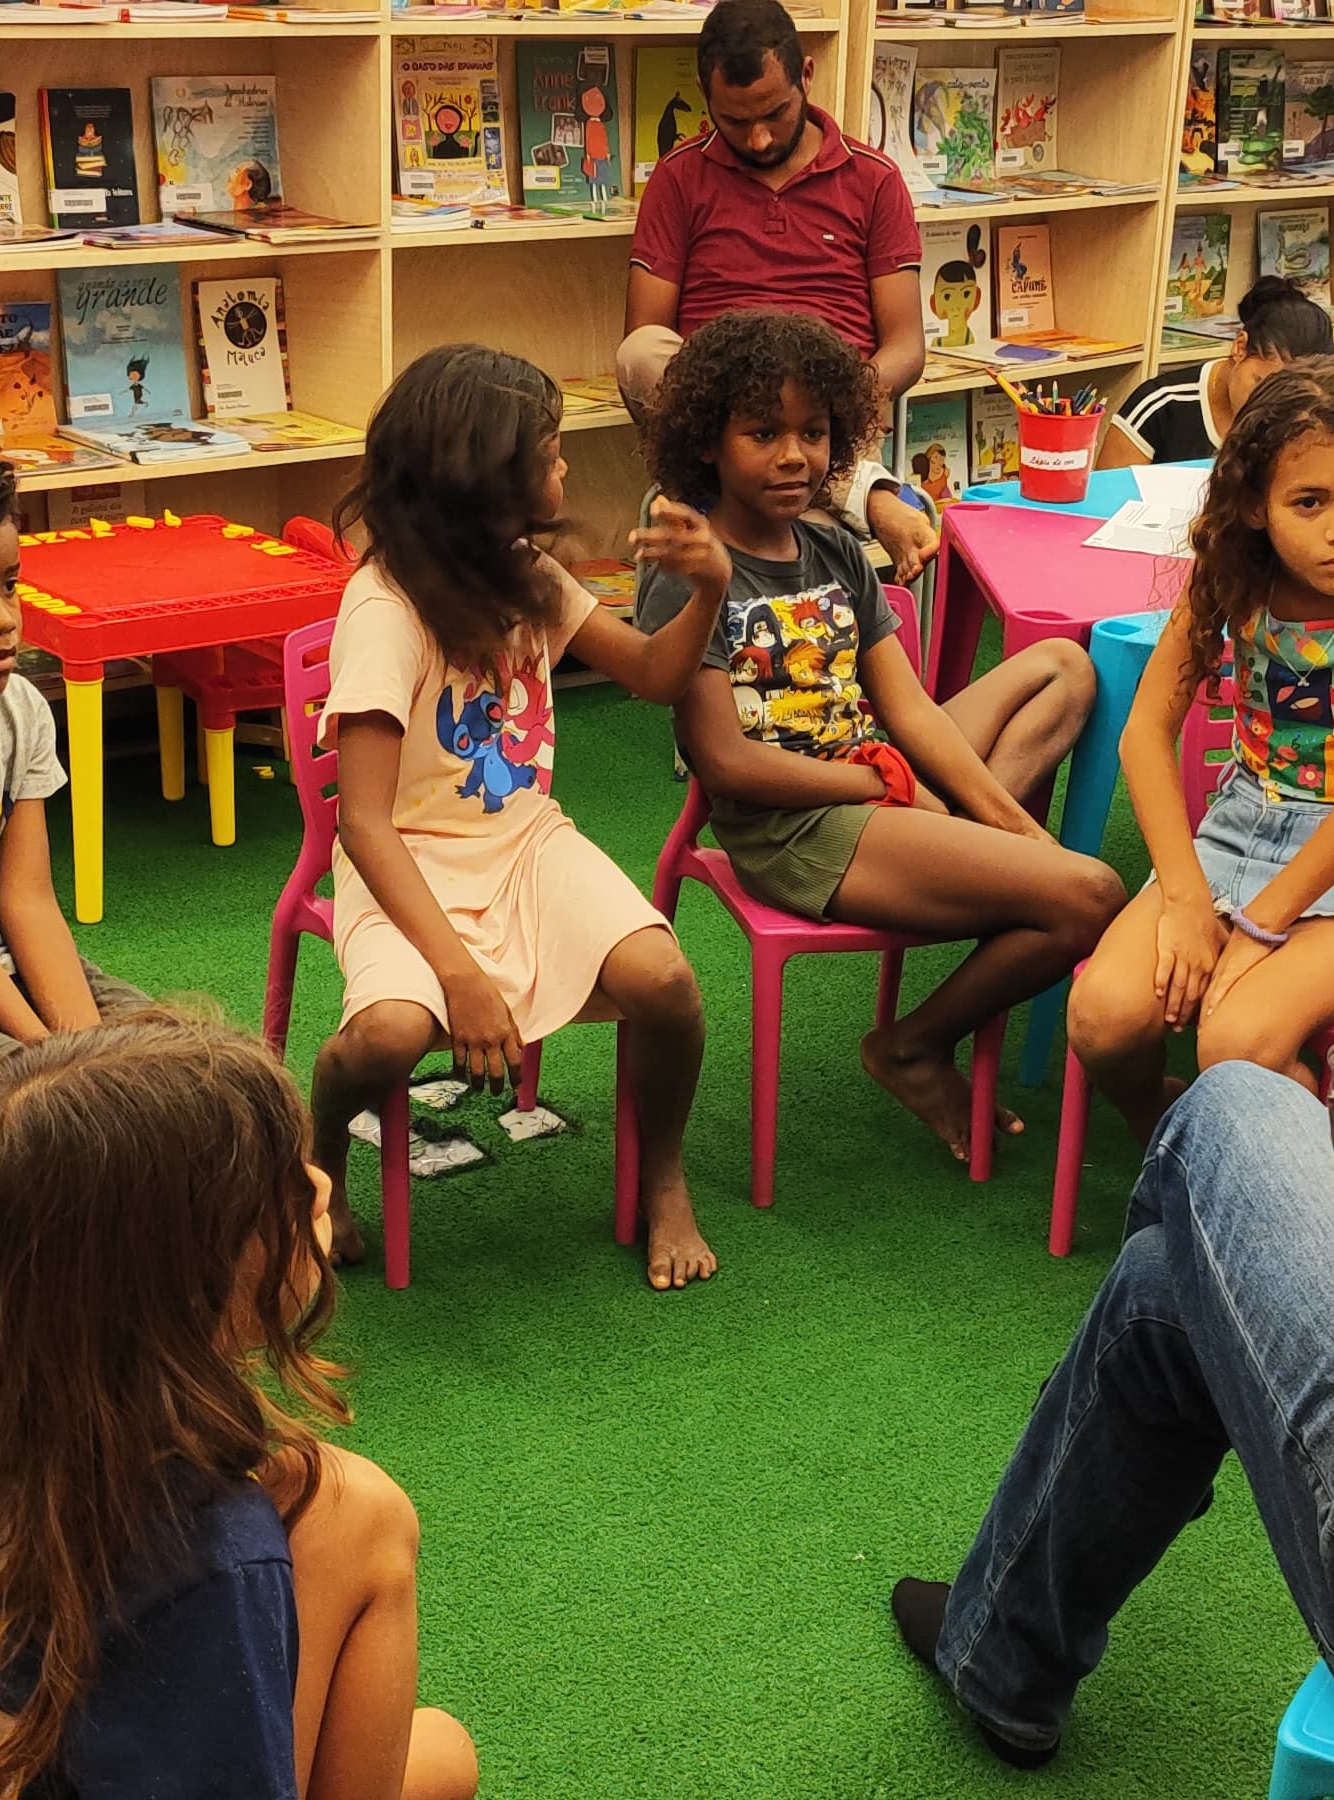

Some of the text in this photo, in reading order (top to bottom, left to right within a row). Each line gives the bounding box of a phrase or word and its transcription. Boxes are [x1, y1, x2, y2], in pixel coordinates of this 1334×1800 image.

[75, 277, 167, 325] grande
[210, 290, 271, 330] Anatomia
[227, 347, 266, 367] Maluca
